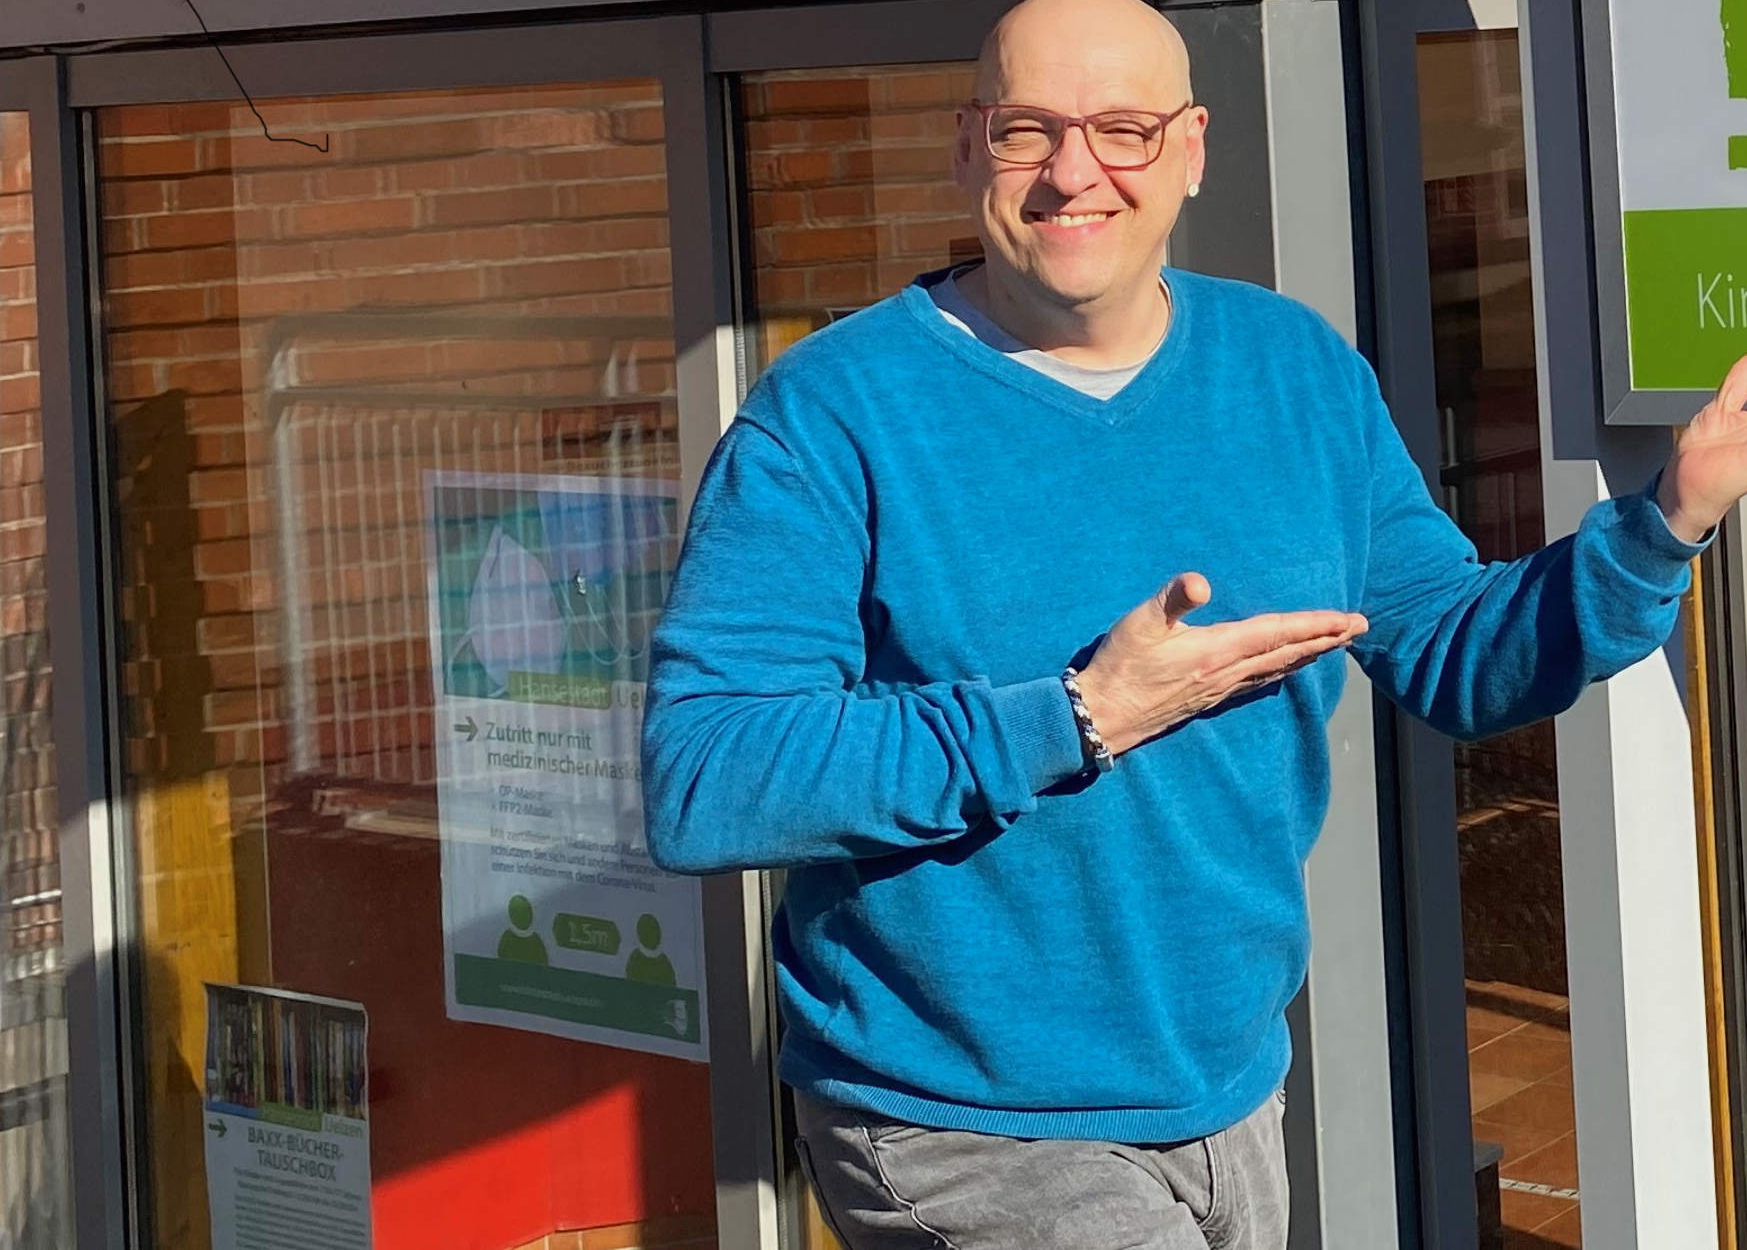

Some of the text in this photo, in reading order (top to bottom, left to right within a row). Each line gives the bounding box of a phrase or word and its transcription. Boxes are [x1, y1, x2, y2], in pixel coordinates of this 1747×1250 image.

[519, 677, 645, 710] Hansestadt Uel
[485, 722, 593, 751] Zutritt nur mit
[487, 750, 591, 778] medizinischer
[256, 1148, 338, 1183] TAUSCHBOX
